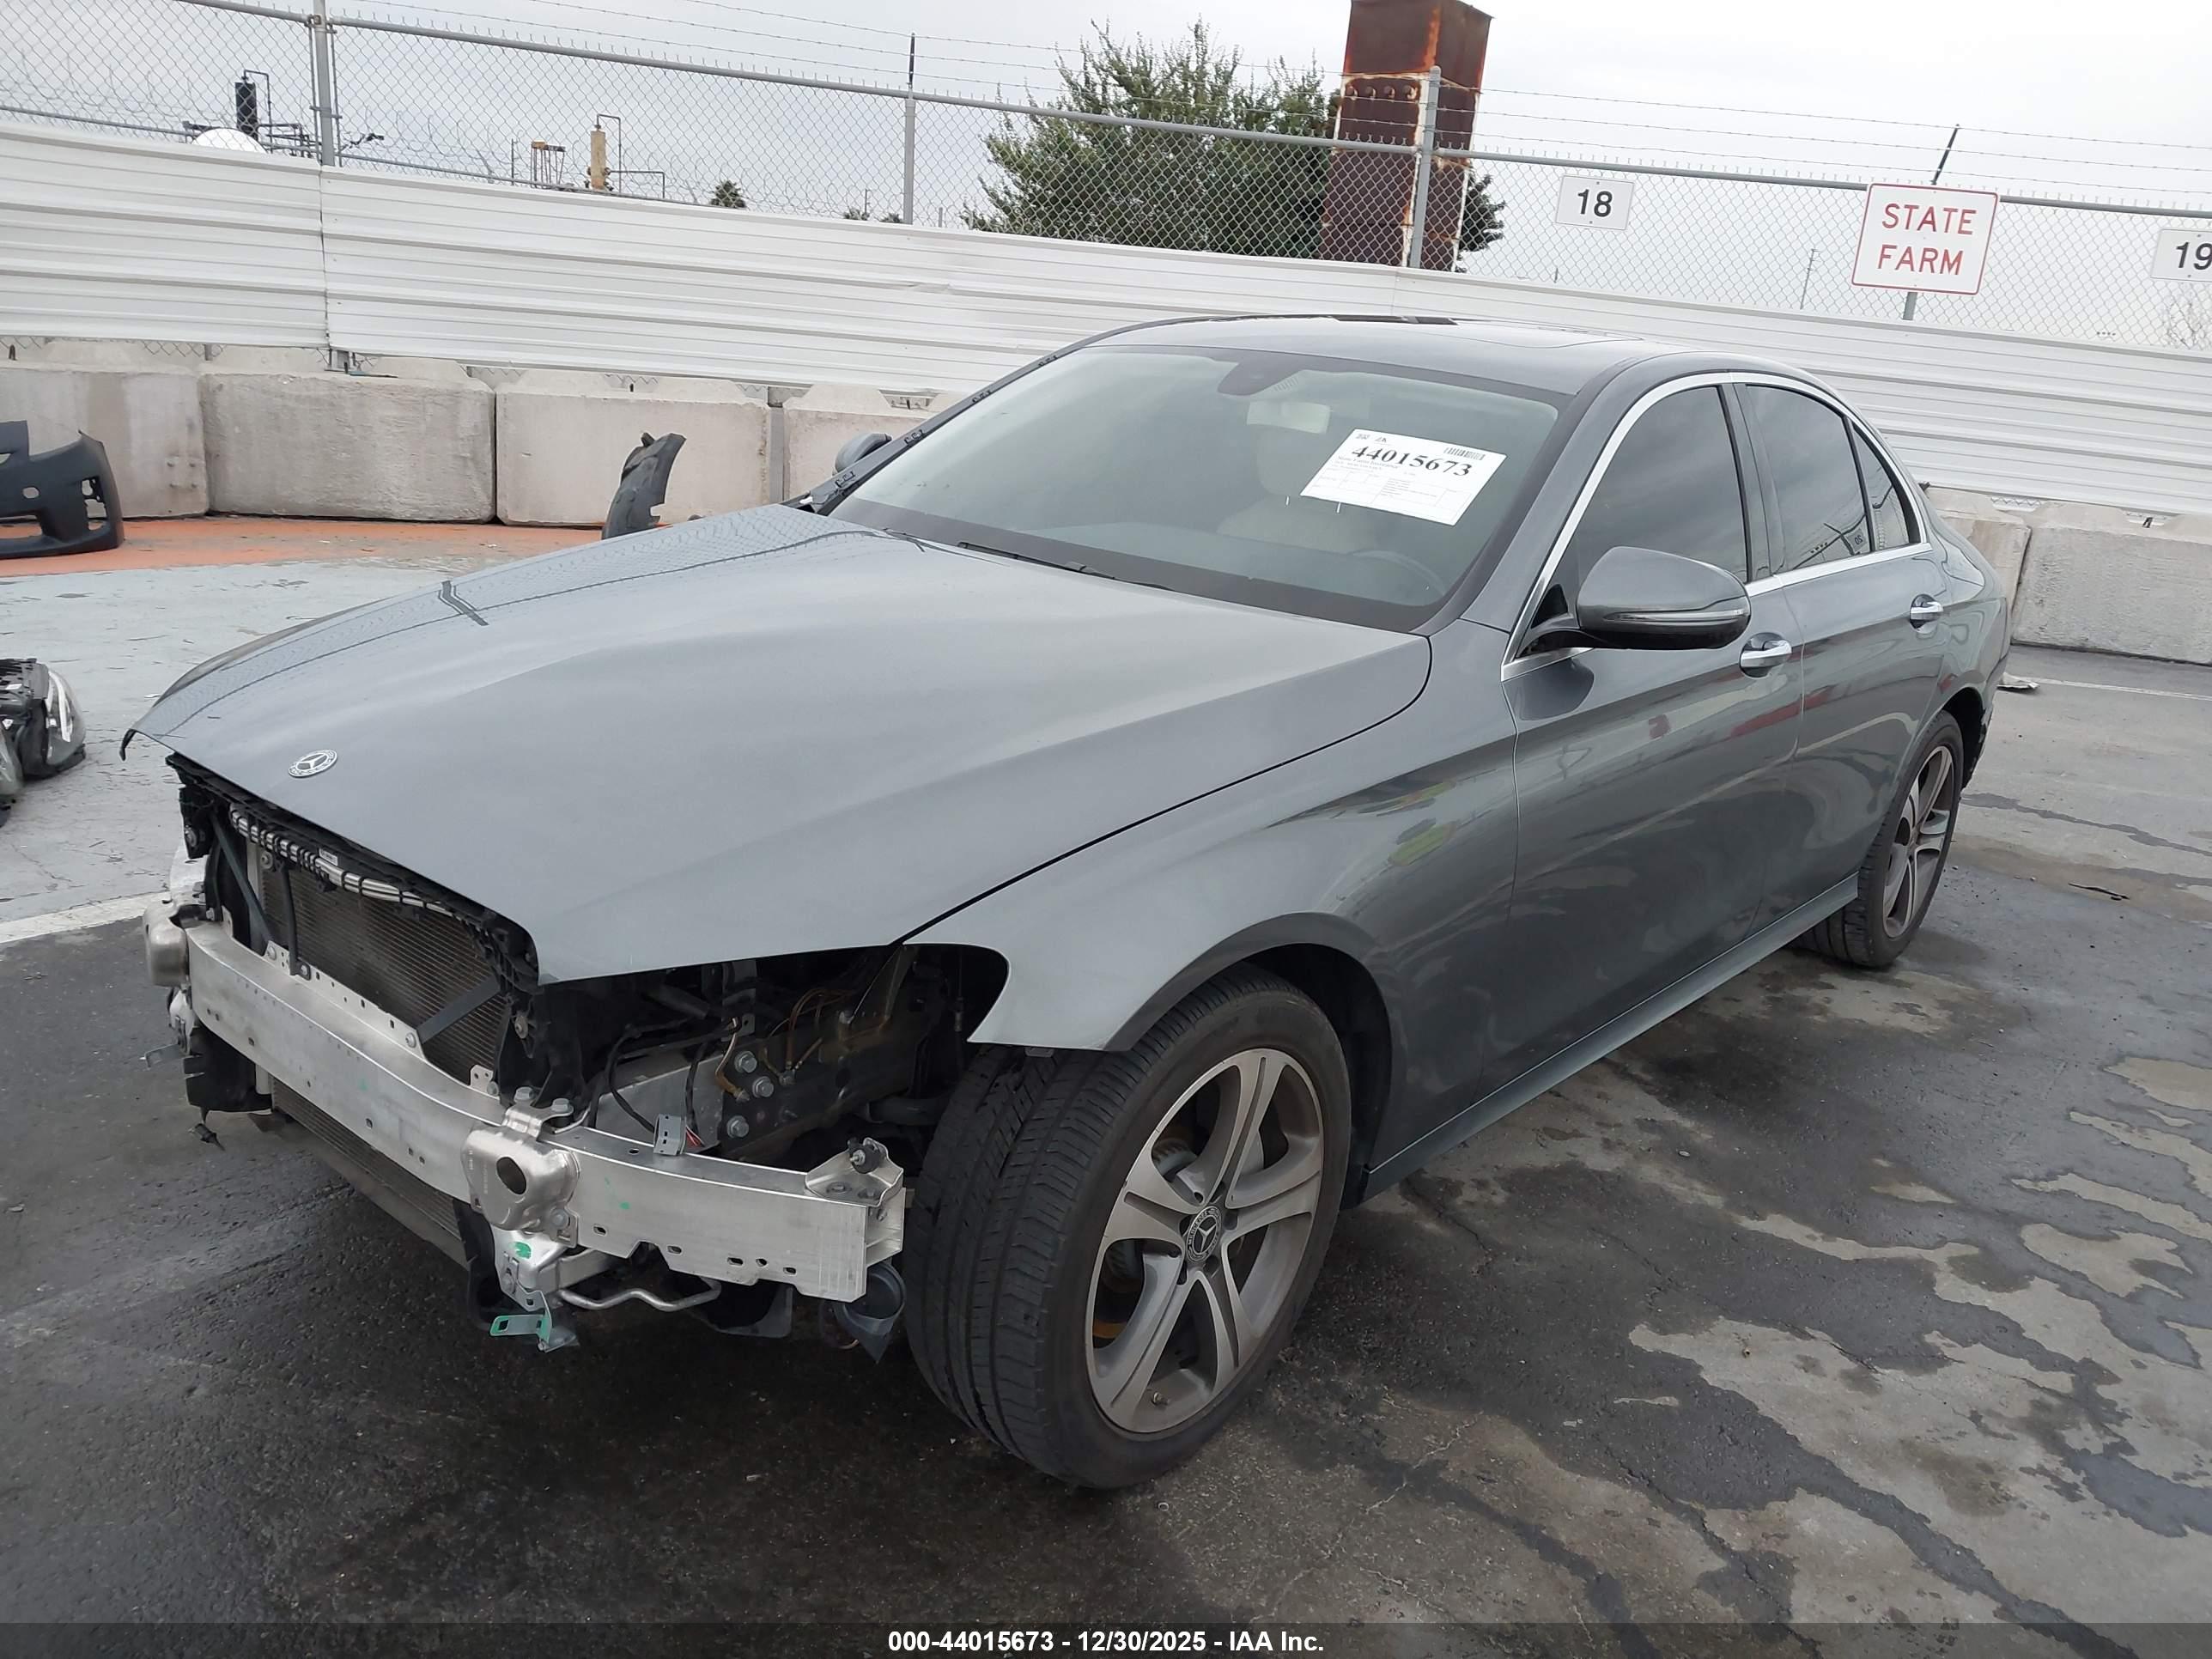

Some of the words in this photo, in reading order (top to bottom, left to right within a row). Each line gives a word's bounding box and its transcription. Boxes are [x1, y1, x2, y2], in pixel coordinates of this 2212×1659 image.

[1577, 188, 1613, 217] 18
[1881, 203, 1977, 235] STATE
[1877, 244, 1964, 276] FARM
[2176, 241, 2212, 270] 19
[1352, 446, 1473, 477] 44015673
